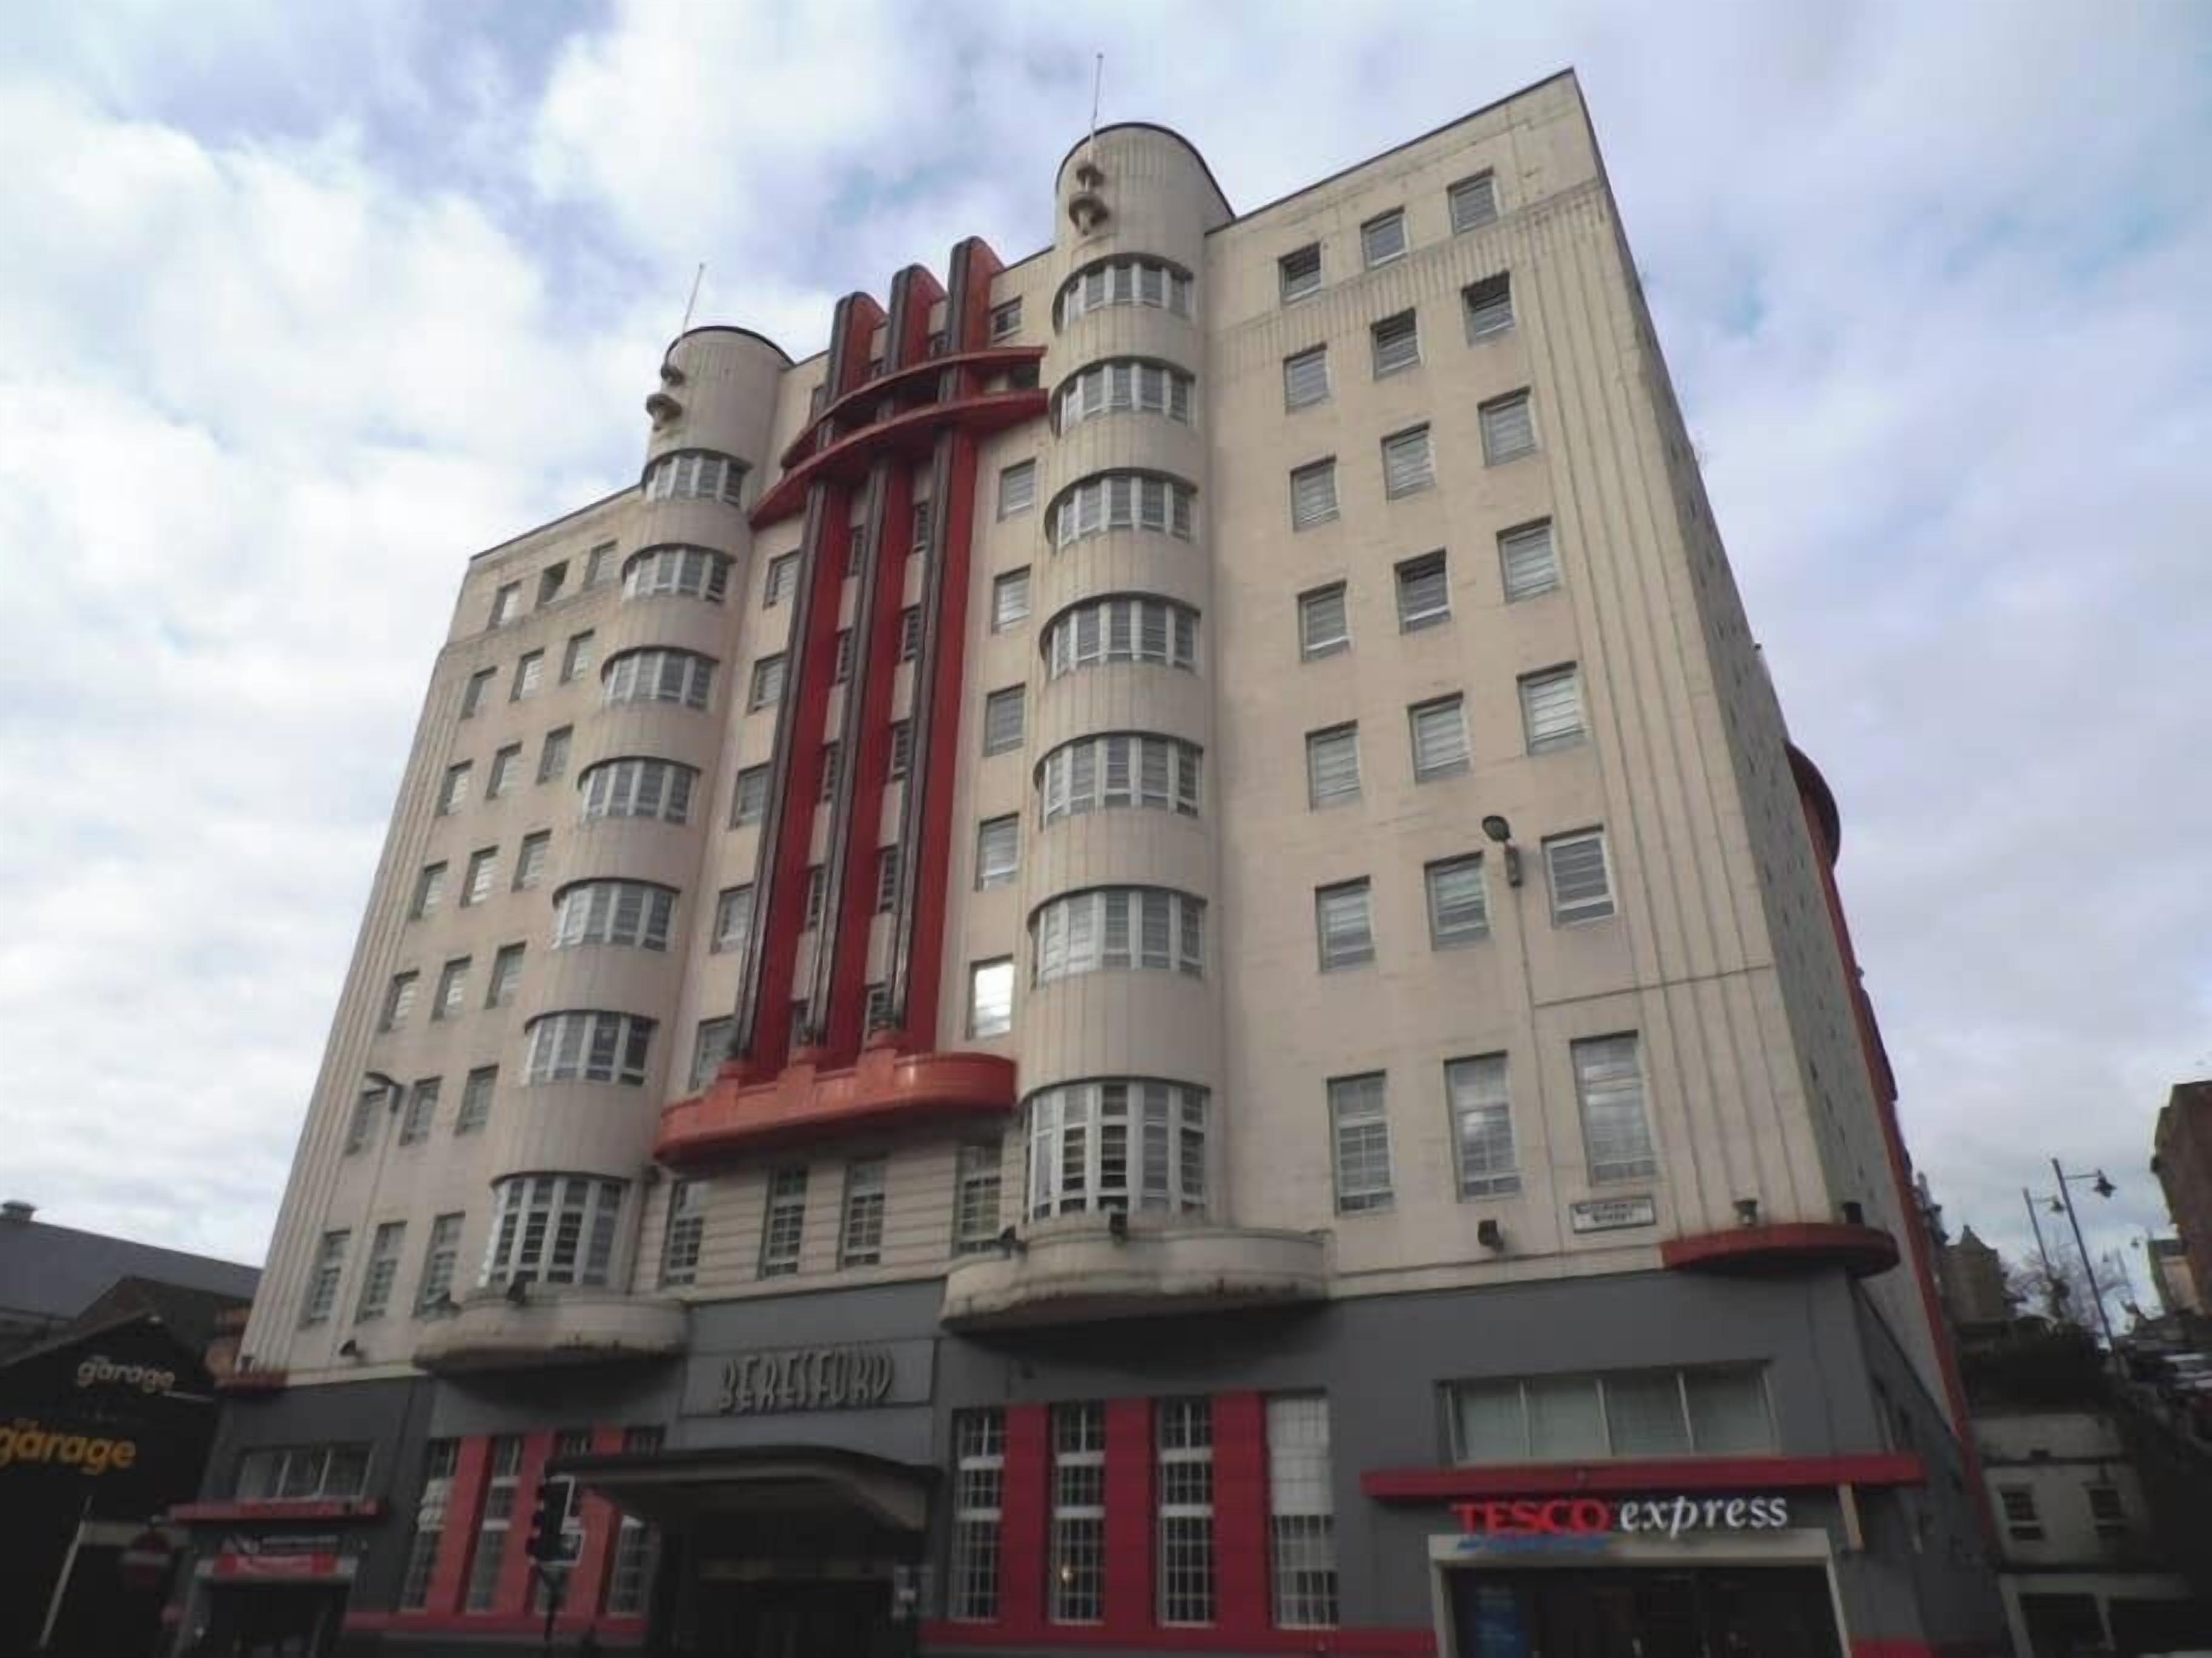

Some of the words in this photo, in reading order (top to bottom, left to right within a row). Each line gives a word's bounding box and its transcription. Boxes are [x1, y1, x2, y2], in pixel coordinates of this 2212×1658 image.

[76, 1361, 175, 1393] garage
[1453, 1498, 1610, 1535] TESCO
[1620, 1495, 1788, 1538] express
